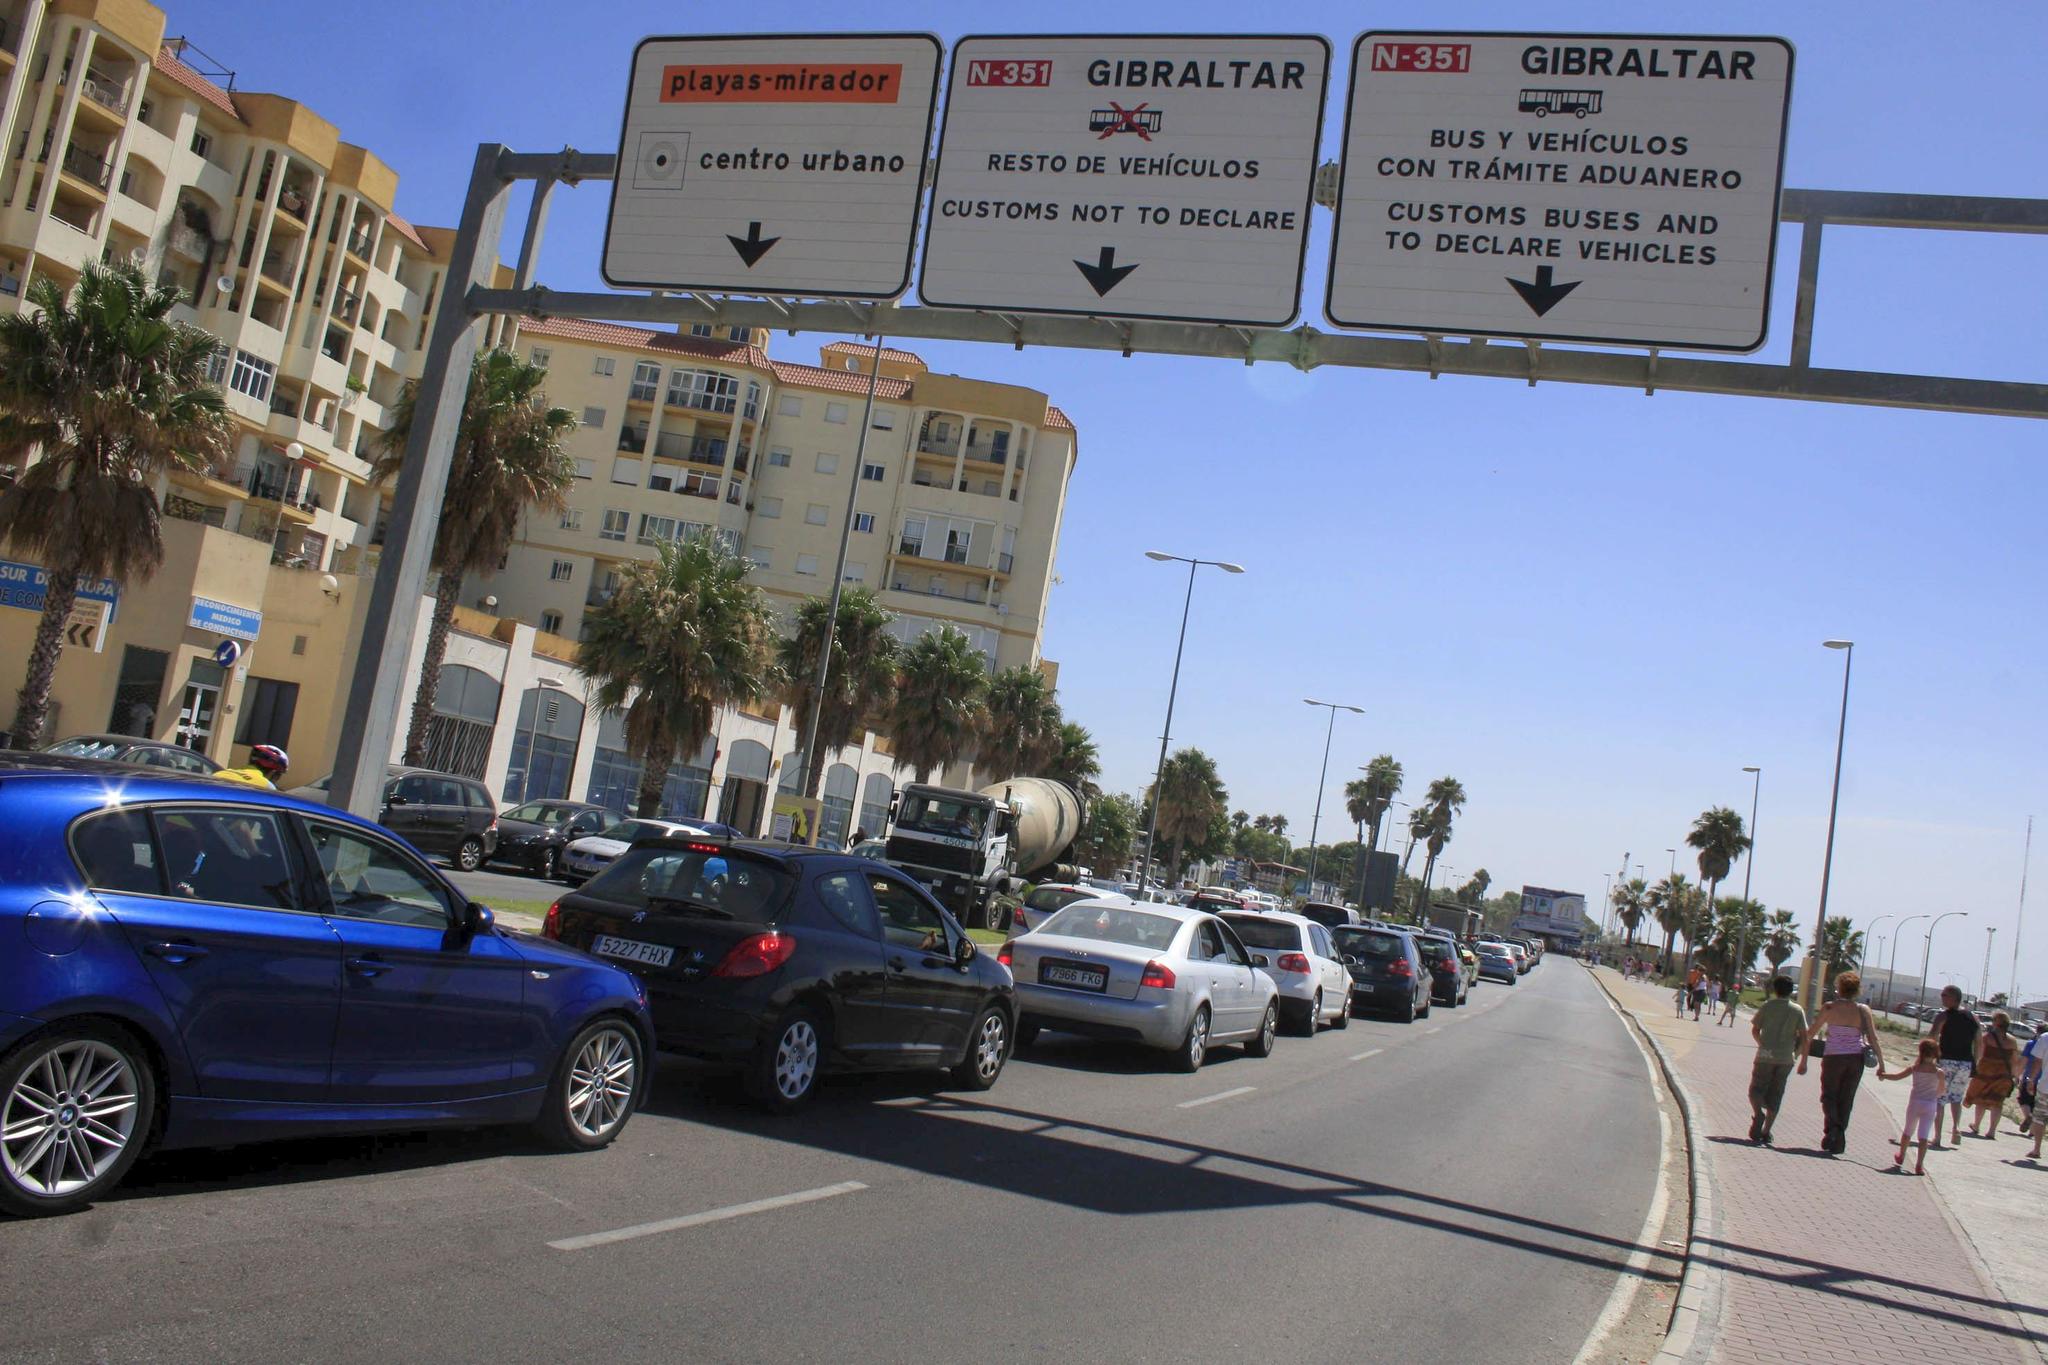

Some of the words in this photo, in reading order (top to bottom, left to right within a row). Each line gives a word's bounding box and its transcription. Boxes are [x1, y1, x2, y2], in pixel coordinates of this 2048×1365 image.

[1375, 45, 1468, 71] N-351
[1521, 46, 1756, 81] GIBRALTAR
[669, 68, 890, 97] playas-mirador
[969, 60, 1051, 86] N-351
[1087, 60, 1305, 89] GIBRALTAR
[1430, 129, 1485, 149] BUS
[1498, 131, 1513, 149] Y
[1527, 128, 1689, 155] VEHÍCULOS
[700, 148, 790, 171] centro
[803, 150, 905, 174] urbano
[987, 153, 1067, 173] RESTO
[1076, 156, 1106, 173] DE
[1119, 152, 1259, 178] VEHÍCULOS
[1377, 157, 1436, 177] CON
[1448, 156, 1569, 183] TRÁMITE
[1579, 165, 1742, 190] ADUANERO
[941, 199, 1059, 220] CUSTOMS
[1071, 205, 1125, 223] NOT
[1137, 206, 1170, 224] TO
[1179, 208, 1296, 230] DECLARE
[1387, 202, 1527, 226] CUSTOMS
[1544, 208, 1640, 231] BUSES
[1656, 214, 1719, 235] AND
[1385, 231, 1421, 250] TO
[1435, 233, 1562, 258] DECLARE
[1578, 241, 1717, 265] VEHICLES
[0, 566, 27, 583] SUR
[194, 597, 261, 620] RECONOCIMIENTO
[602, 938, 638, 957] 5227
[639, 945, 669, 964] FHX
[1052, 967, 1077, 981] 7966
